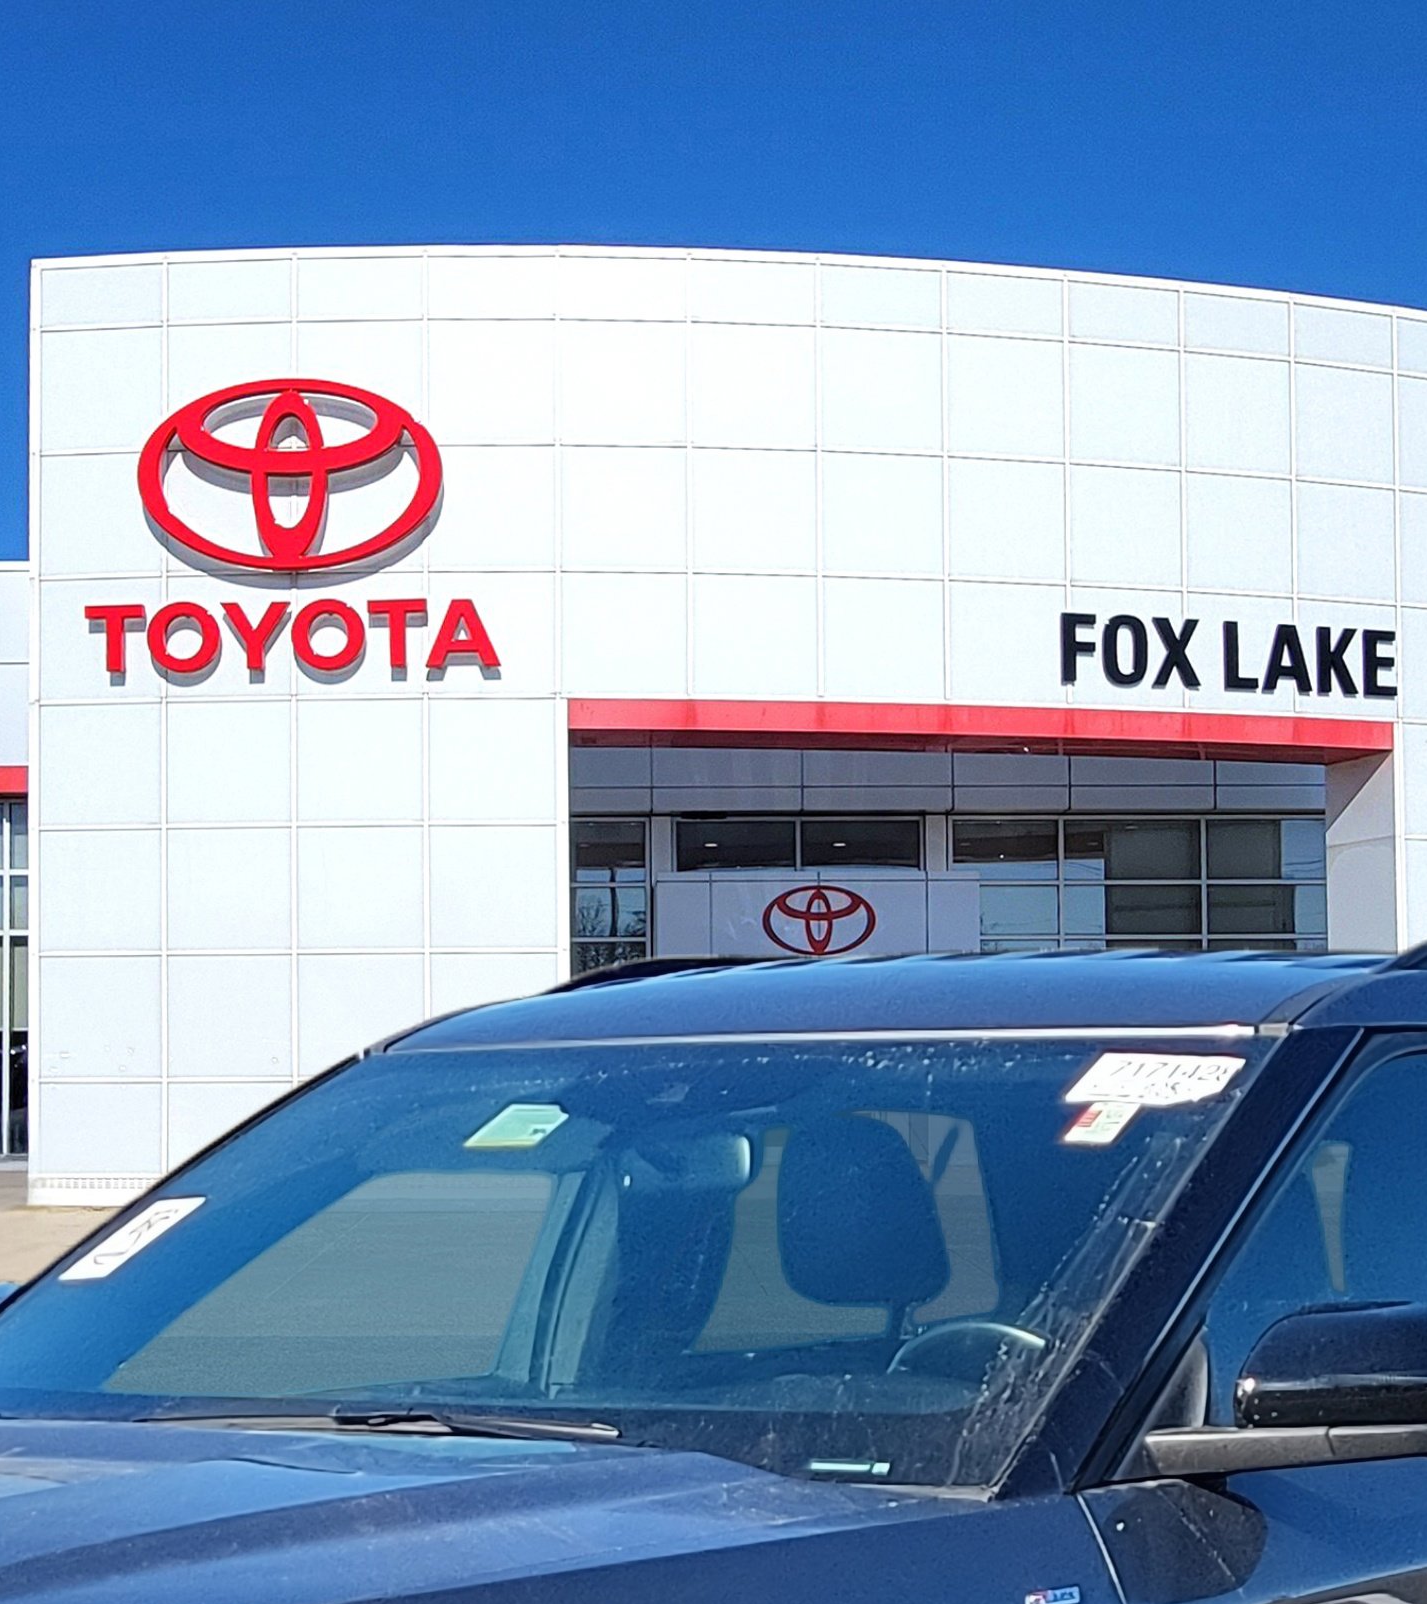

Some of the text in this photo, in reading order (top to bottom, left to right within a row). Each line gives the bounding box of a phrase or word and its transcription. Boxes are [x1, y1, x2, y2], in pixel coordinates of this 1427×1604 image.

[85, 599, 502, 674] TOYOTA
[1060, 612, 1398, 698] FOX LAKE
